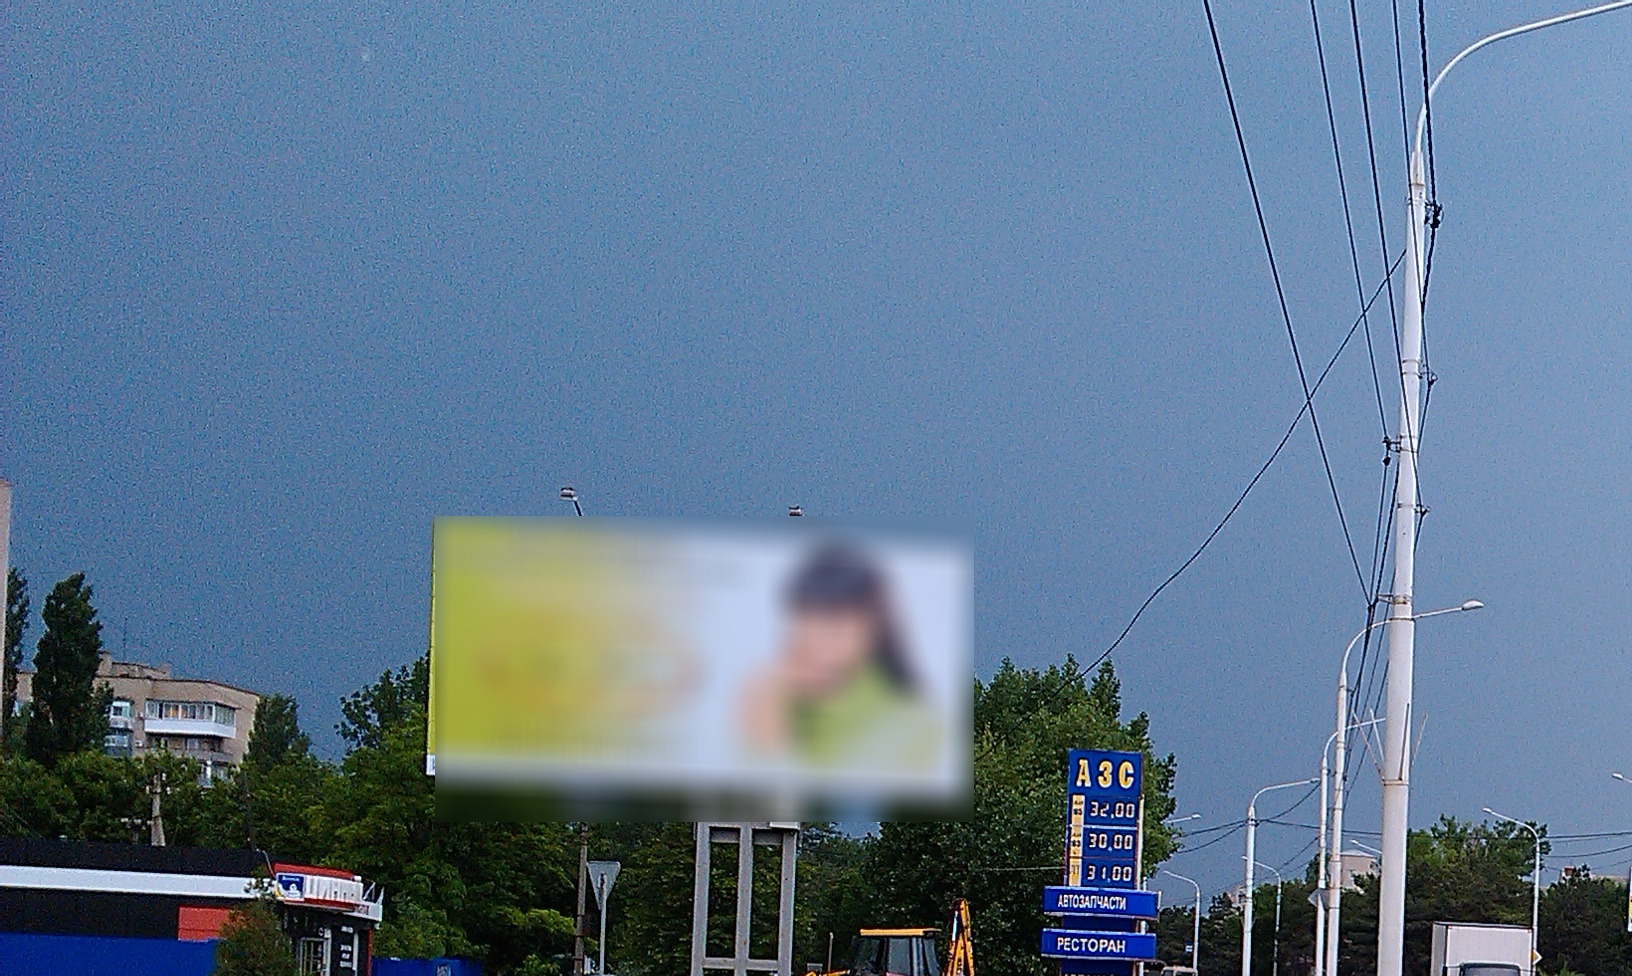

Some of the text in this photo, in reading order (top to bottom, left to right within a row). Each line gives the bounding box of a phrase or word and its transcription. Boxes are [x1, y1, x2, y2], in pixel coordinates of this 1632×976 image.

[1076, 759, 1134, 789] АЗС
[1089, 801, 1135, 819] 32,00
[1057, 894, 1126, 910] АВТОЗАПЧАСТИ
[1057, 937, 1126, 953] РЕСТОРАН
